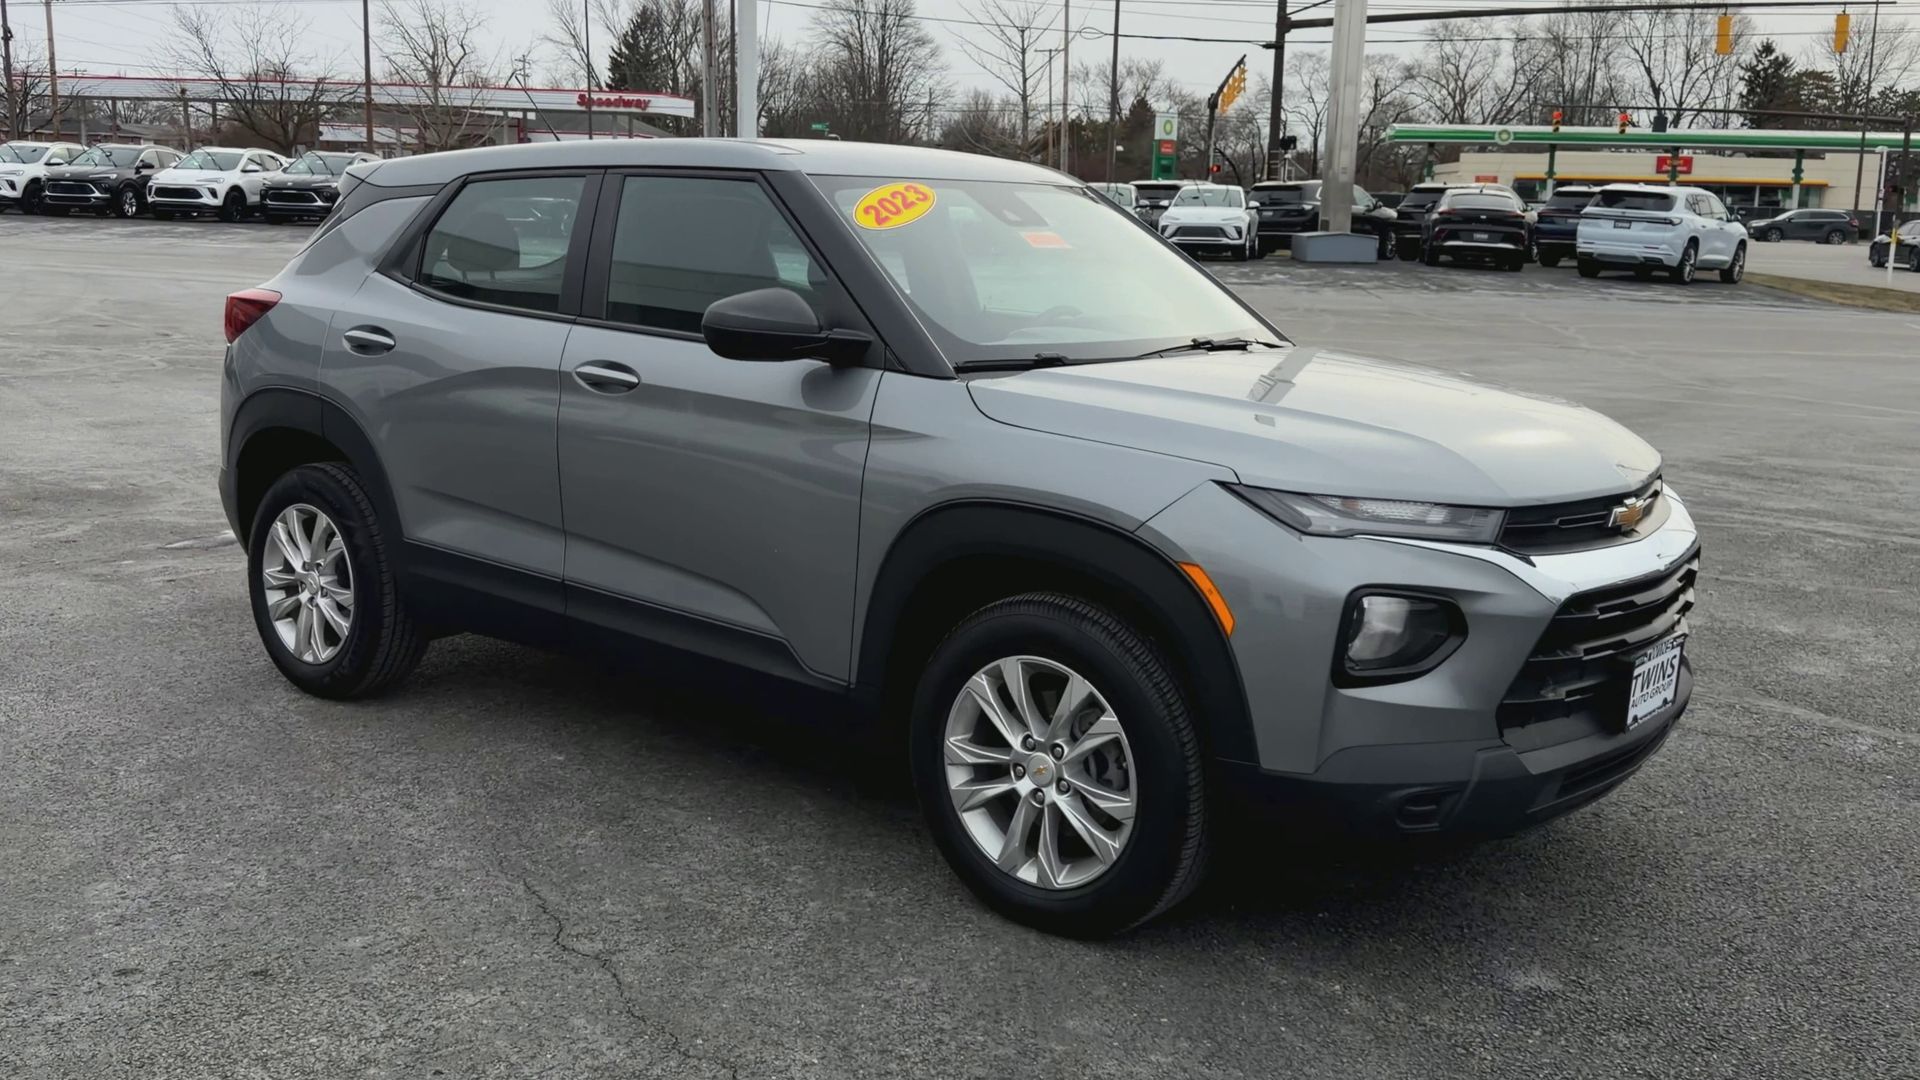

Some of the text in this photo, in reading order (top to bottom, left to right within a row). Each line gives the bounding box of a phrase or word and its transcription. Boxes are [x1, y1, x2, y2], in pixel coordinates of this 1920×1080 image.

[577, 94, 651, 111] Speedway
[863, 184, 929, 226] 2023
[1631, 679, 1673, 708] AUTO GROUP
[1632, 654, 1677, 698] TWINS
